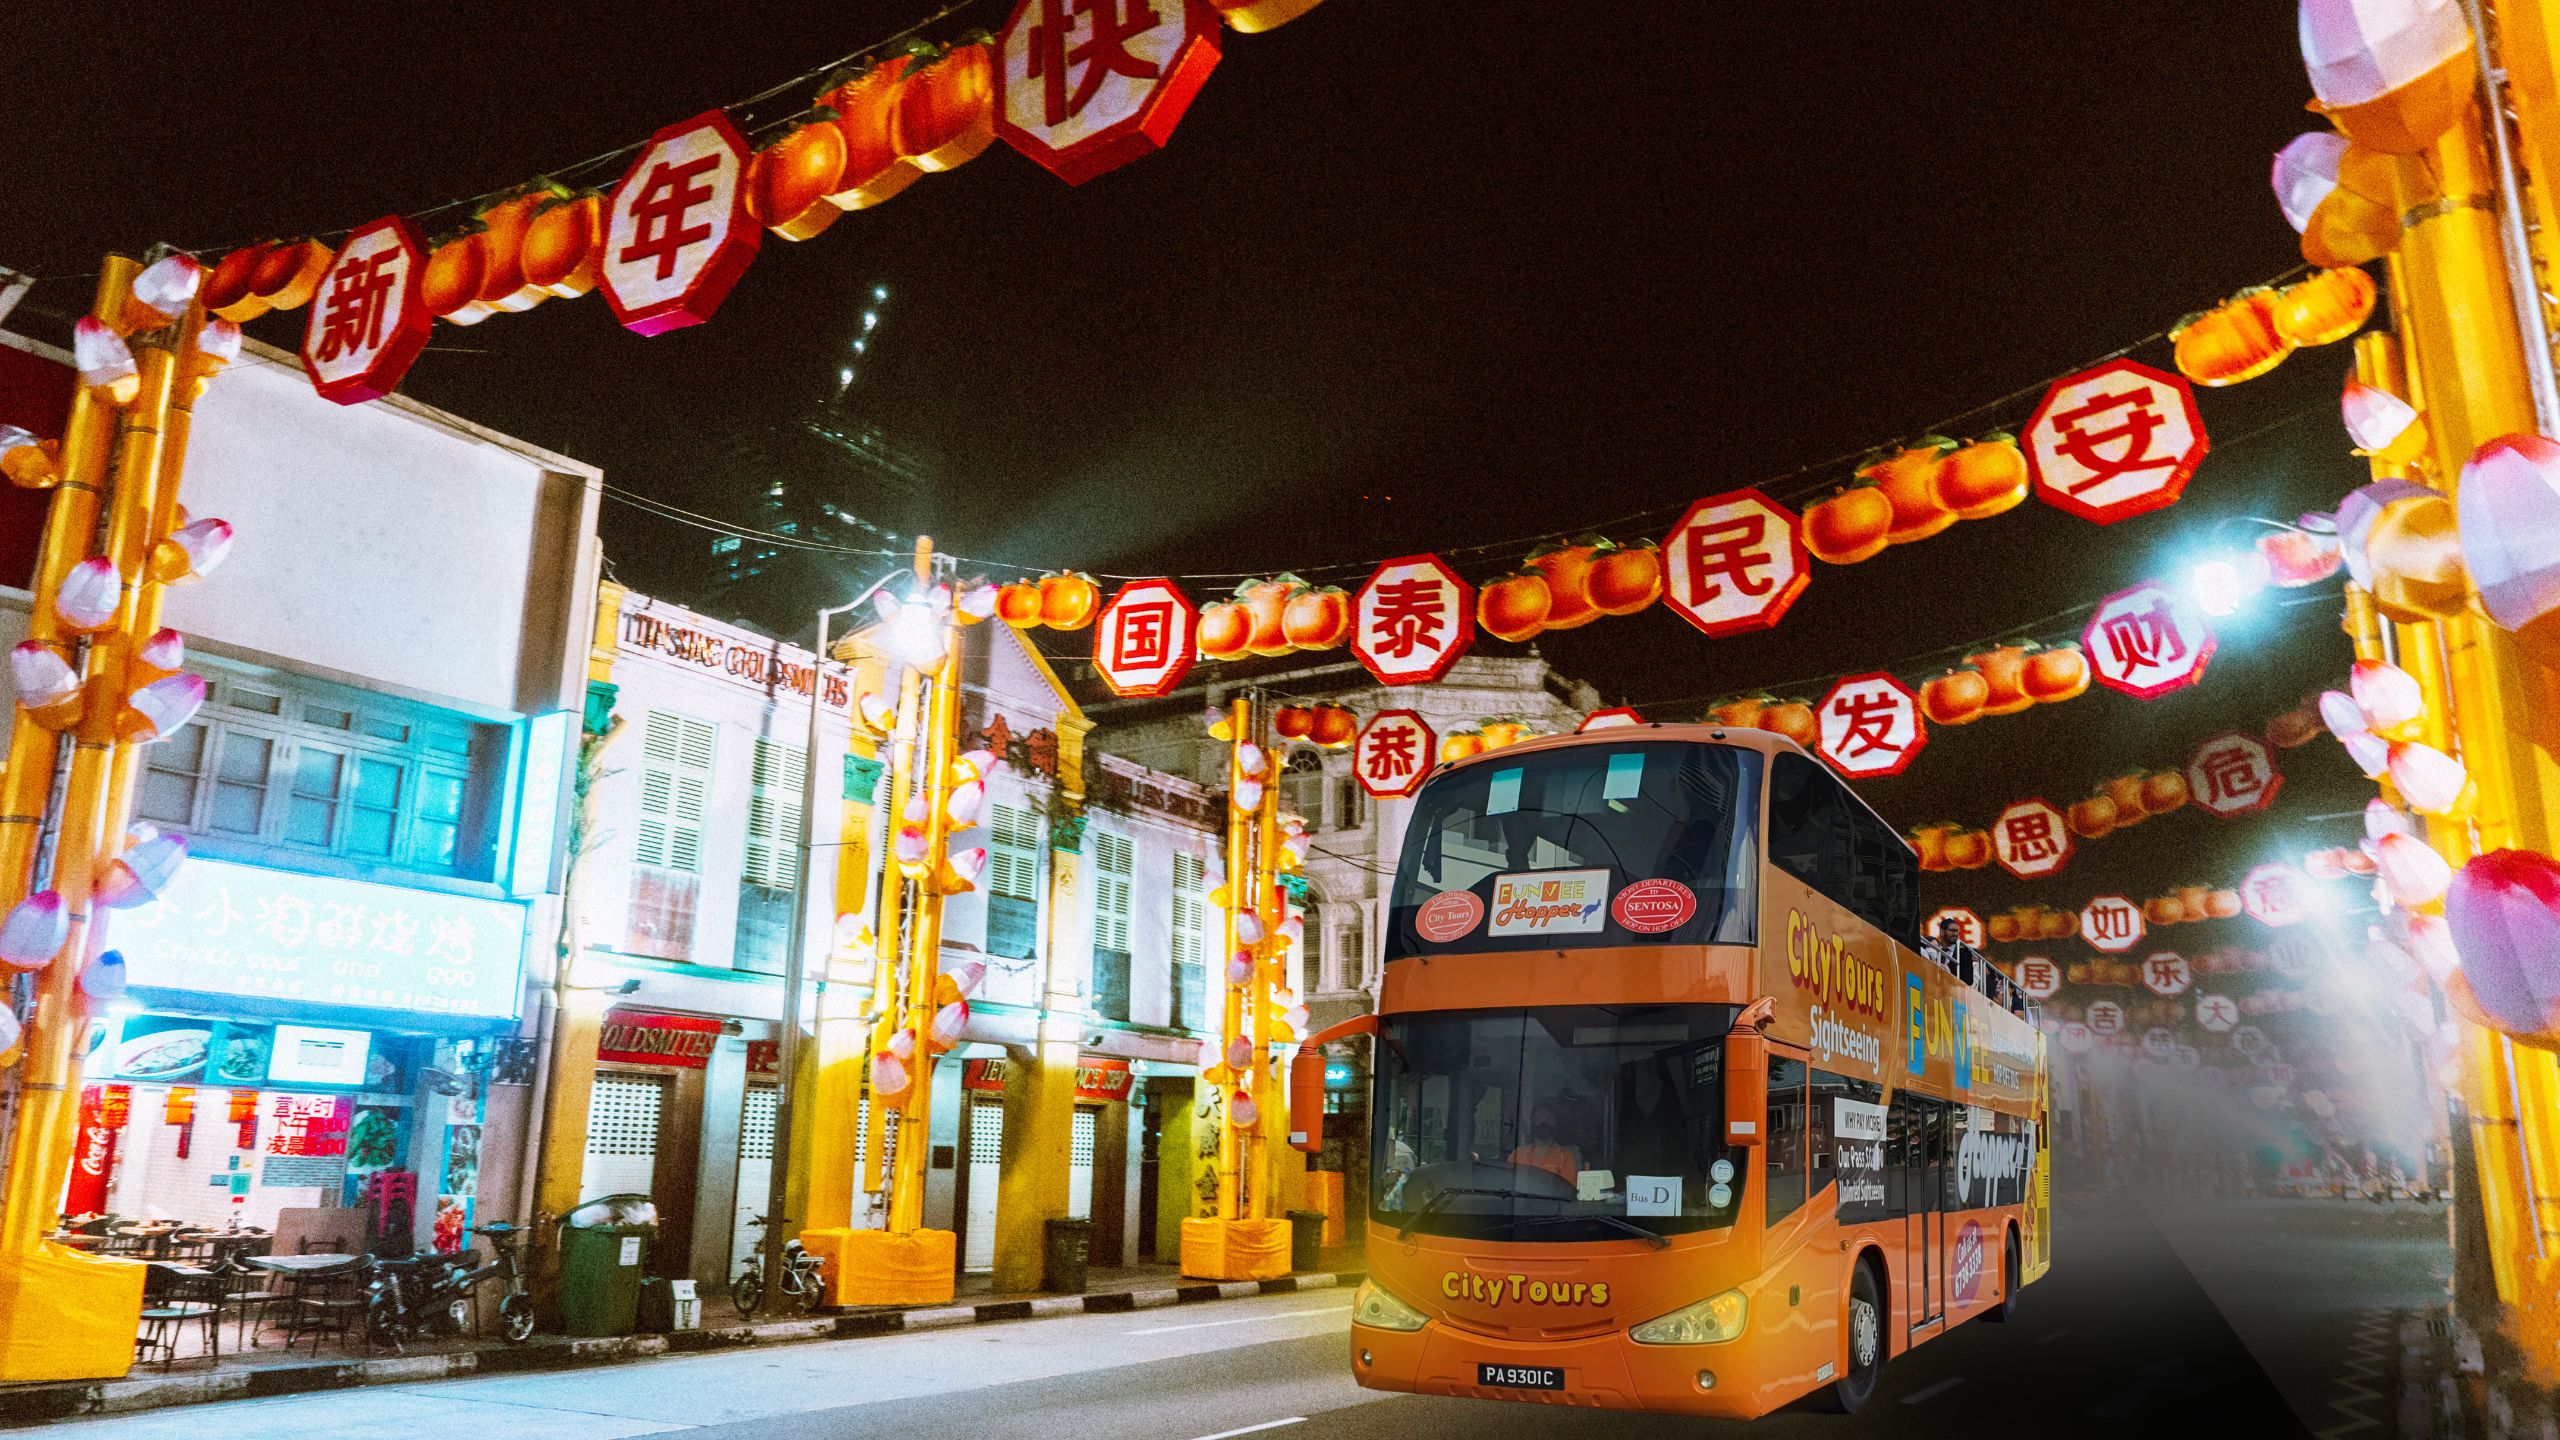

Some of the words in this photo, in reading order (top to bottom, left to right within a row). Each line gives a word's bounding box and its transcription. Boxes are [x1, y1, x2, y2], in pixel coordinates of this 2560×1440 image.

[317, 246, 399, 362] 新
[620, 152, 722, 281] 年
[1025, 0, 1164, 126] 快
[1113, 603, 1171, 668] 国
[1371, 580, 1446, 659] 泰
[1685, 516, 1774, 604] 民
[2053, 387, 2177, 496] 安
[1367, 721, 1424, 782] 恭
[1833, 693, 1903, 758] 发
[2104, 598, 2186, 680] 财
[2006, 814, 2059, 863] 思
[2203, 746, 2263, 801] 危
[1498, 879, 1586, 904] FUNVEE
[1617, 885, 1640, 901] MOST
[1641, 880, 1693, 900] DEPARTURES
[1428, 914, 1445, 924] City
[1447, 911, 1470, 920] Tours
[1496, 899, 1583, 928] Hopper
[1628, 901, 1679, 911] SENTOSA
[1622, 917, 1638, 928] HOP
[1652, 924, 1669, 932] HOP
[1670, 917, 1685, 928] OFF
[2091, 903, 2132, 941] 如
[2152, 960, 2185, 989] 乐
[2093, 1006, 2118, 1030] 吉
[2203, 1000, 2233, 1026] 大
[1810, 1004, 1880, 1076] Sightseeing
[1907, 978, 1991, 1087] FUNVEE
[1838, 1145, 1850, 1168] Our
[1851, 1145, 1865, 1168] Pass
[1630, 1192, 1648, 1202] Bus
[1652, 1186, 1669, 1203] D
